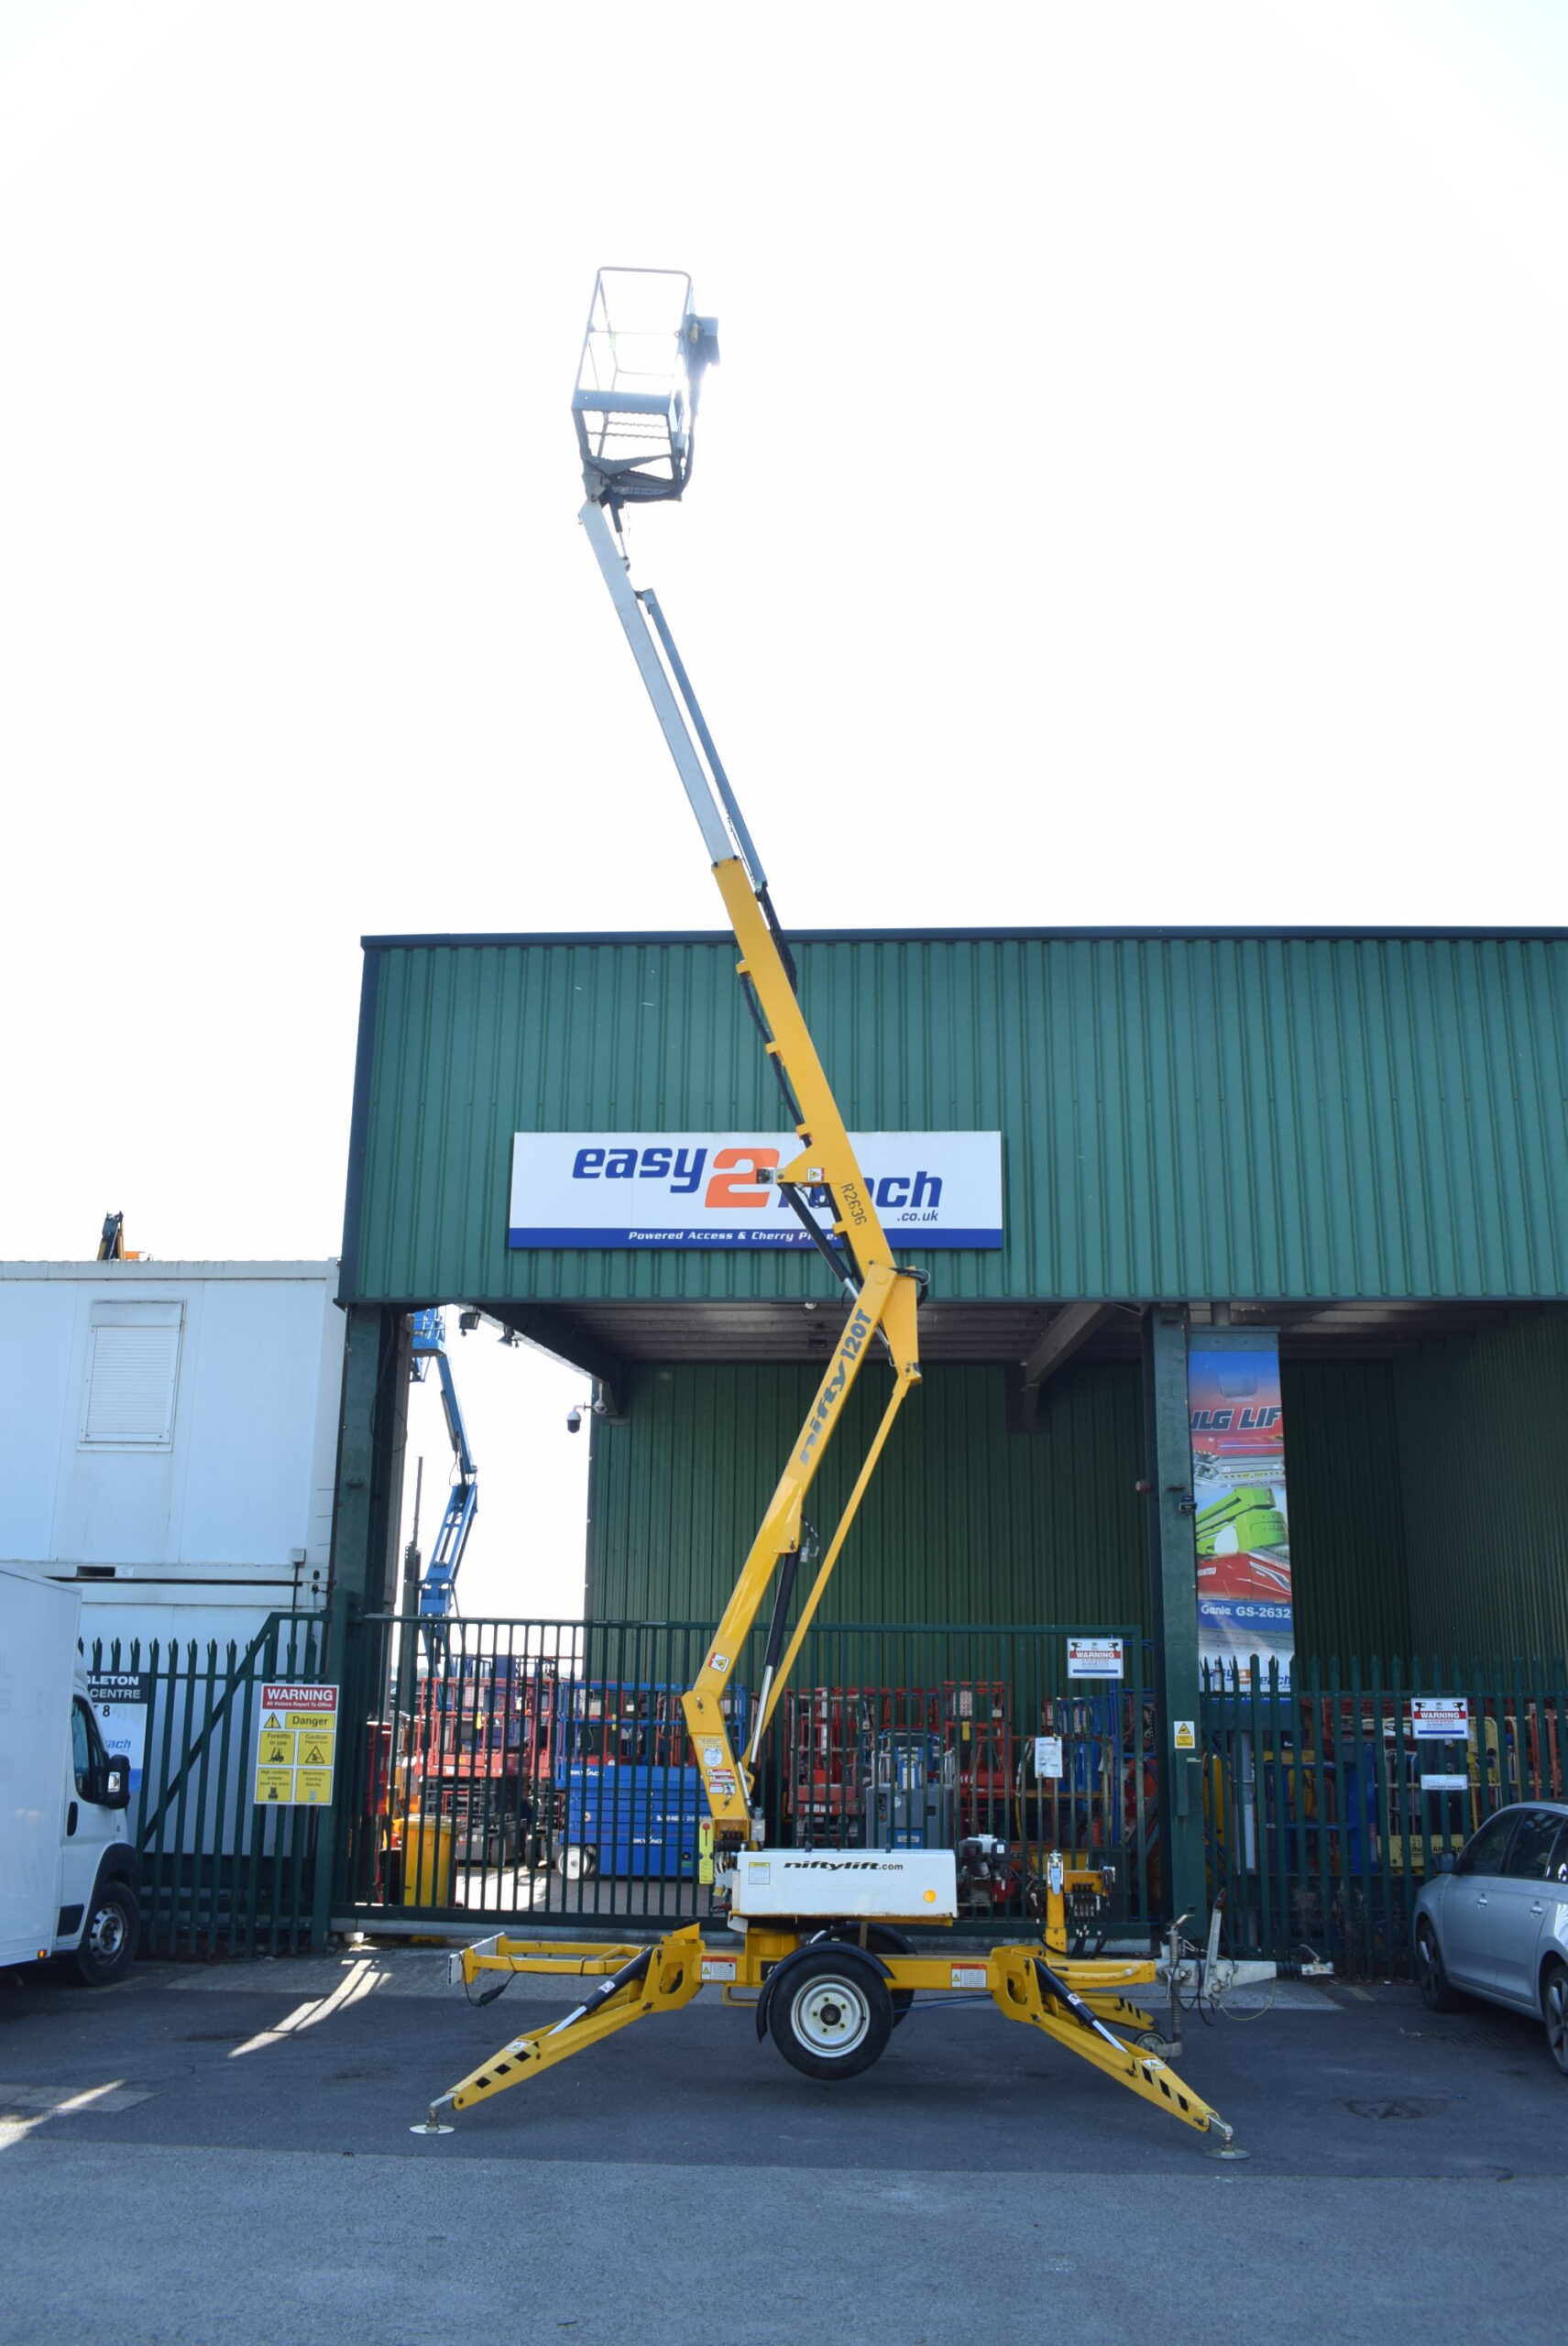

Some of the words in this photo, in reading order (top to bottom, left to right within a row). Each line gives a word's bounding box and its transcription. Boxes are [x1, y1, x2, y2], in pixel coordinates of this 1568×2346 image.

[840, 1183, 867, 1225] R2636
[897, 1210, 938, 1222] .co.uk
[629, 1231, 684, 1240] Powered
[687, 1231, 733, 1240] Access
[738, 1231, 747, 1240] &
[751, 1231, 794, 1243] Cherry
[800, 1359, 846, 1464] nifty
[840, 1309, 872, 1361] 120T
[1201, 1605, 1231, 1615] Genie
[1235, 1606, 1291, 1618] GS-2632
[90, 1688, 141, 1699] CENTRE
[268, 1688, 334, 1701] WARNING
[103, 1705, 110, 1716] 8
[293, 1701, 310, 1709] Report
[1420, 1711, 1460, 1719] WARNING
[292, 1716, 329, 1727] Danger
[784, 1860, 904, 1871] niftylift.com
